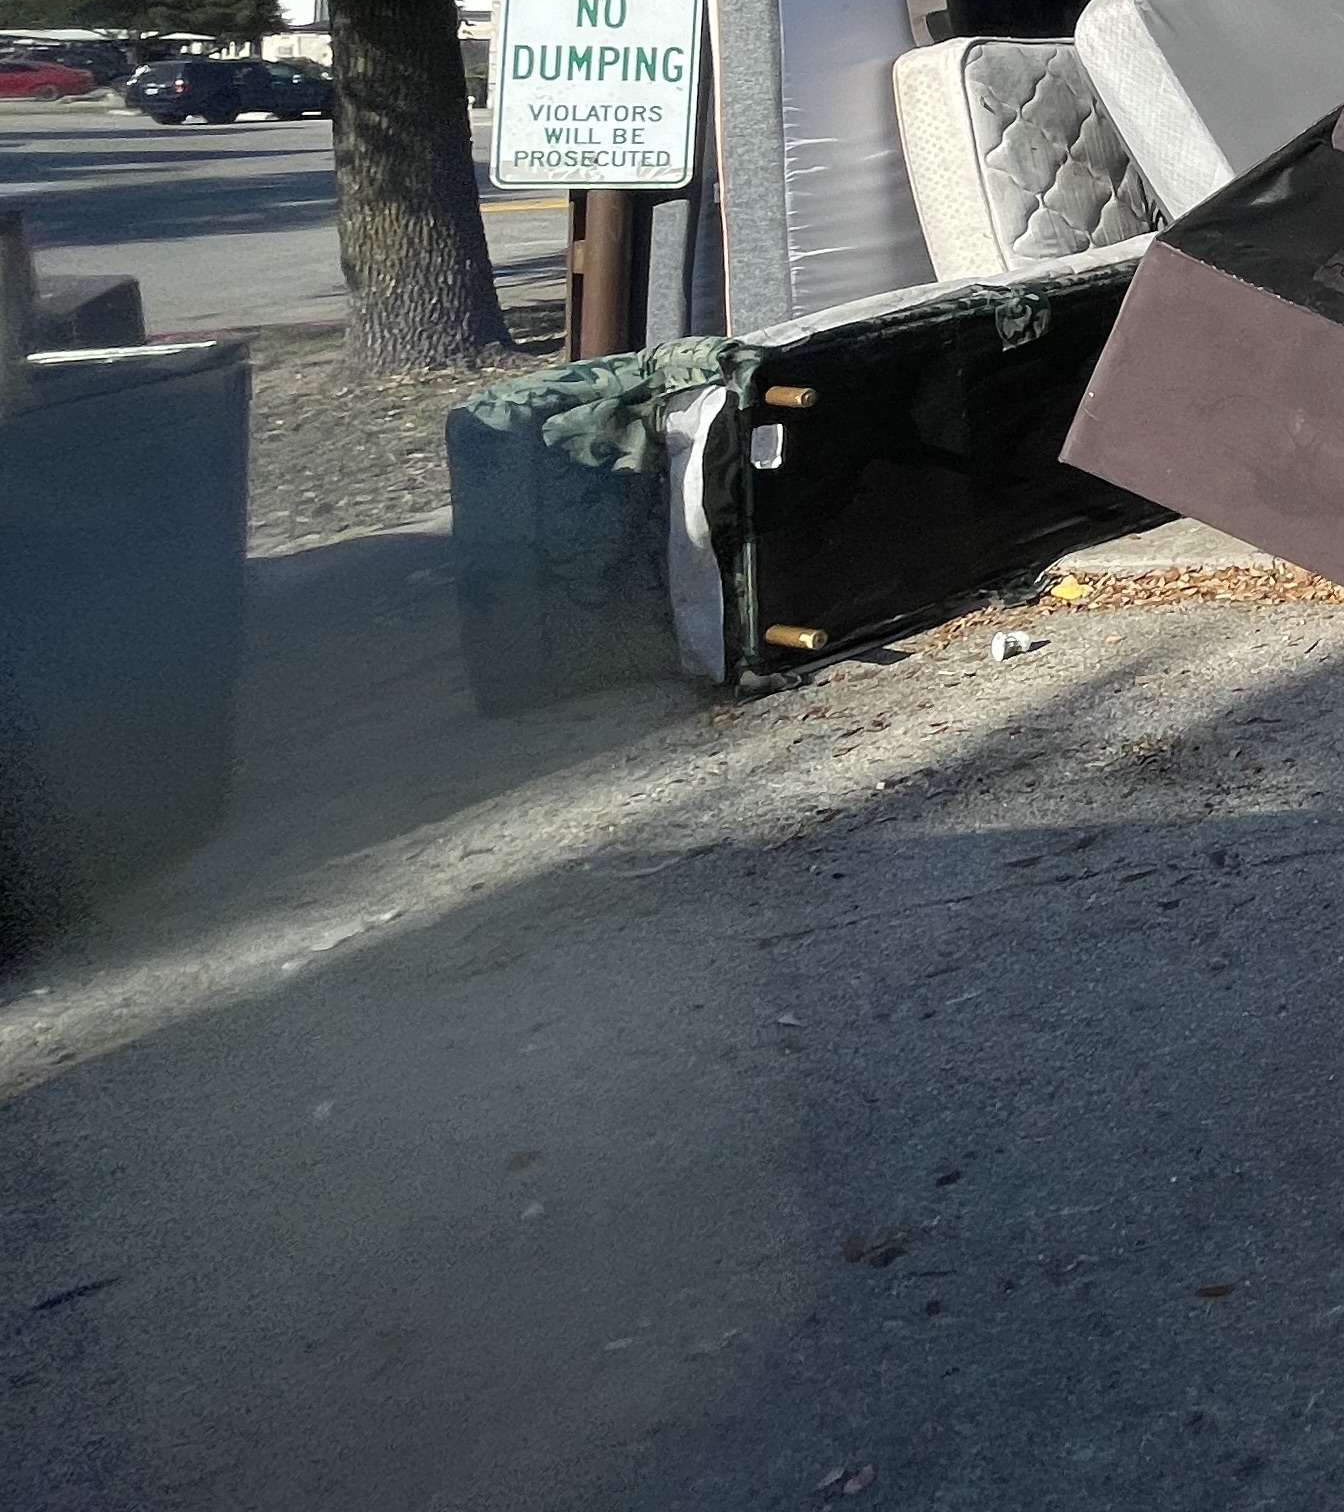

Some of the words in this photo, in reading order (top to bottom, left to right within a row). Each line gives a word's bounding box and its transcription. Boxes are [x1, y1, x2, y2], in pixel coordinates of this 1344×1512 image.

[511, 44, 684, 83] DUMPING
[528, 103, 663, 123] VIOLATORS
[544, 127, 601, 145] WILL
[612, 128, 645, 145] BE
[513, 150, 671, 168] PROSECUTED
